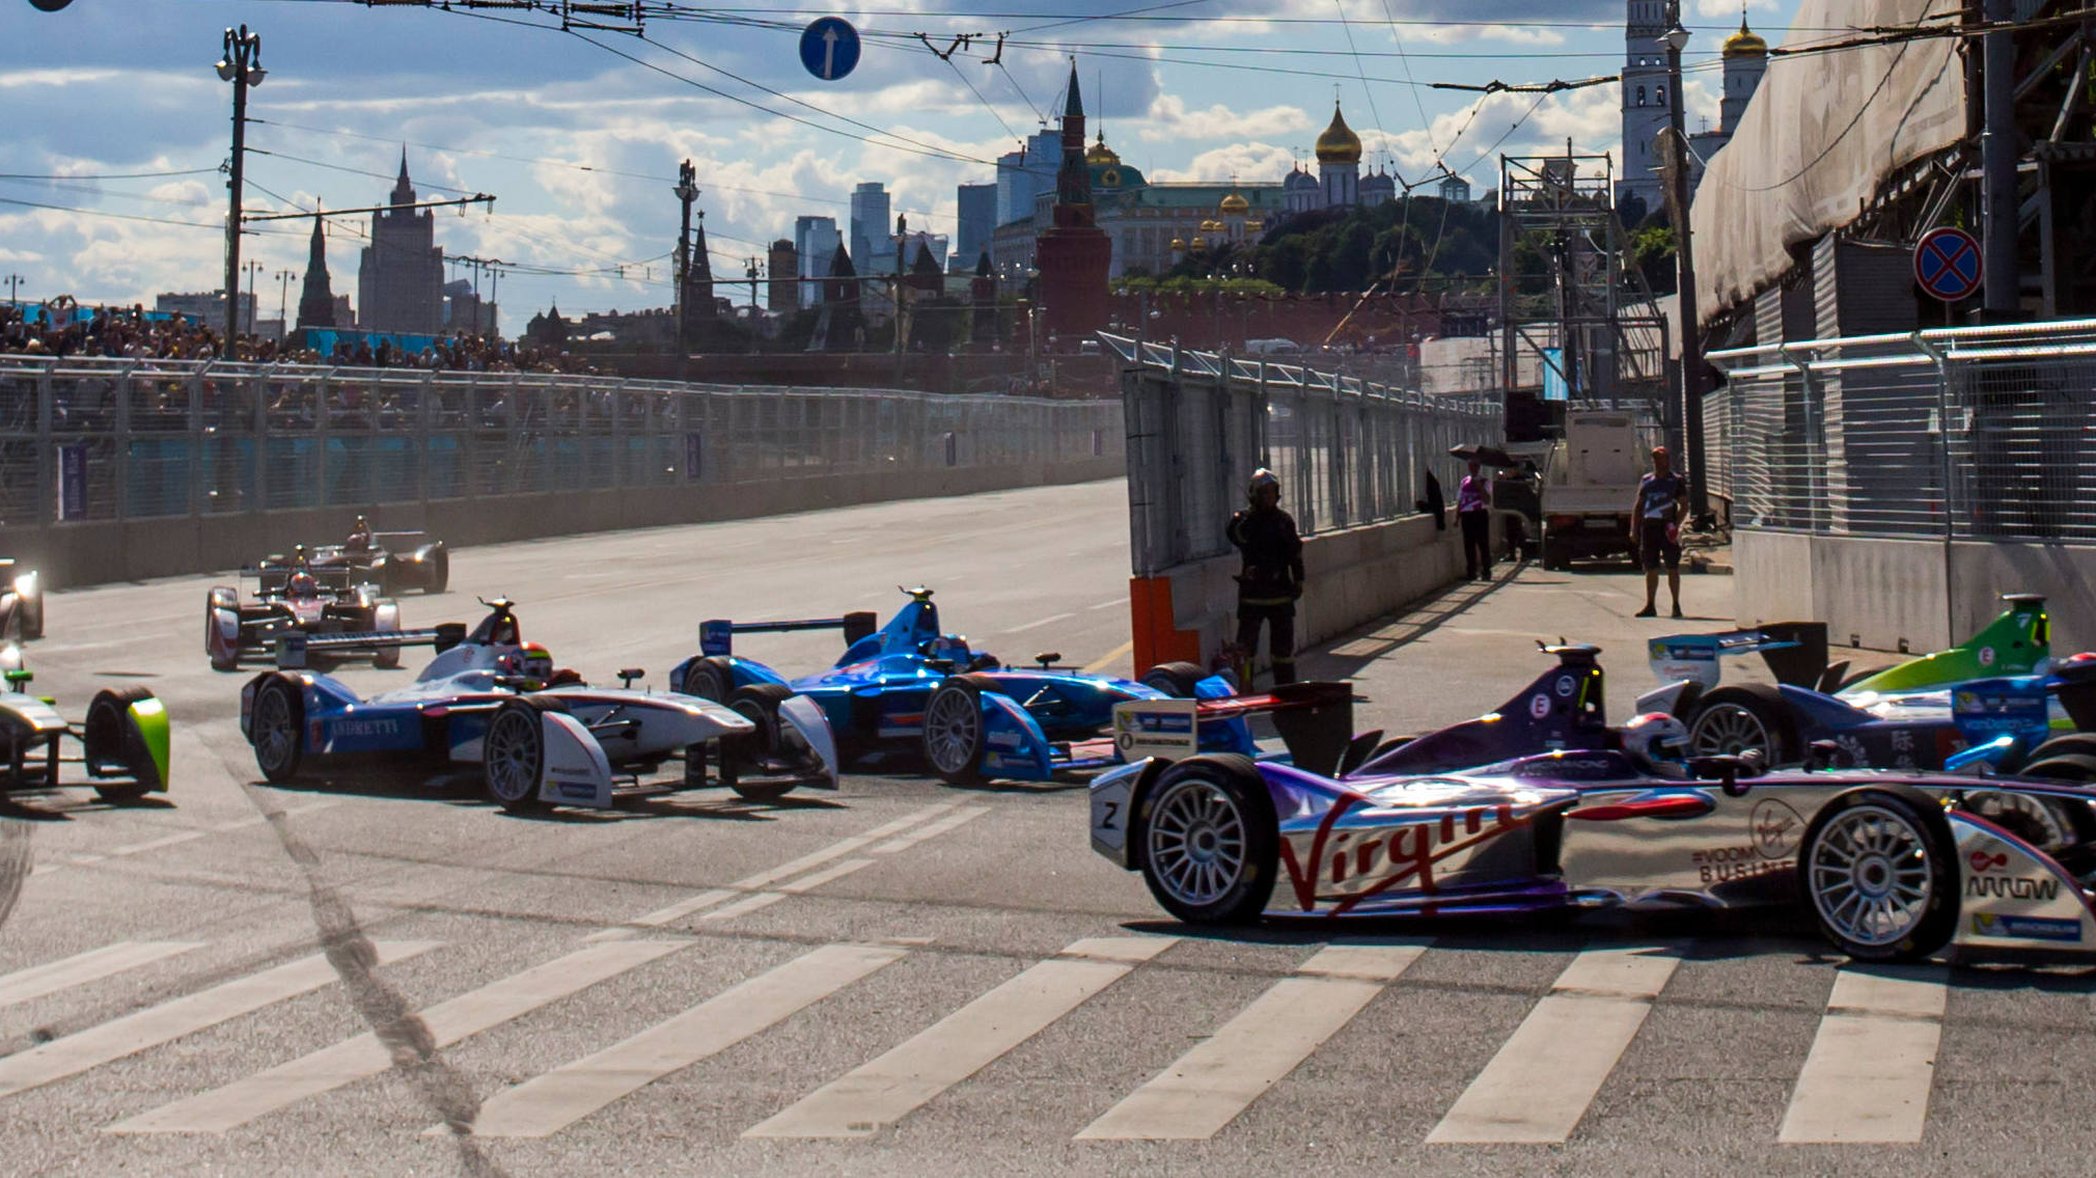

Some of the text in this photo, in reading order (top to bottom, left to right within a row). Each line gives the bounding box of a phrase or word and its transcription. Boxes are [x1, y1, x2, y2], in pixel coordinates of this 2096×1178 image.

[1535, 697, 1546, 714] E
[330, 718, 399, 736] ANDRETTI
[1278, 792, 1535, 918] Virgin
